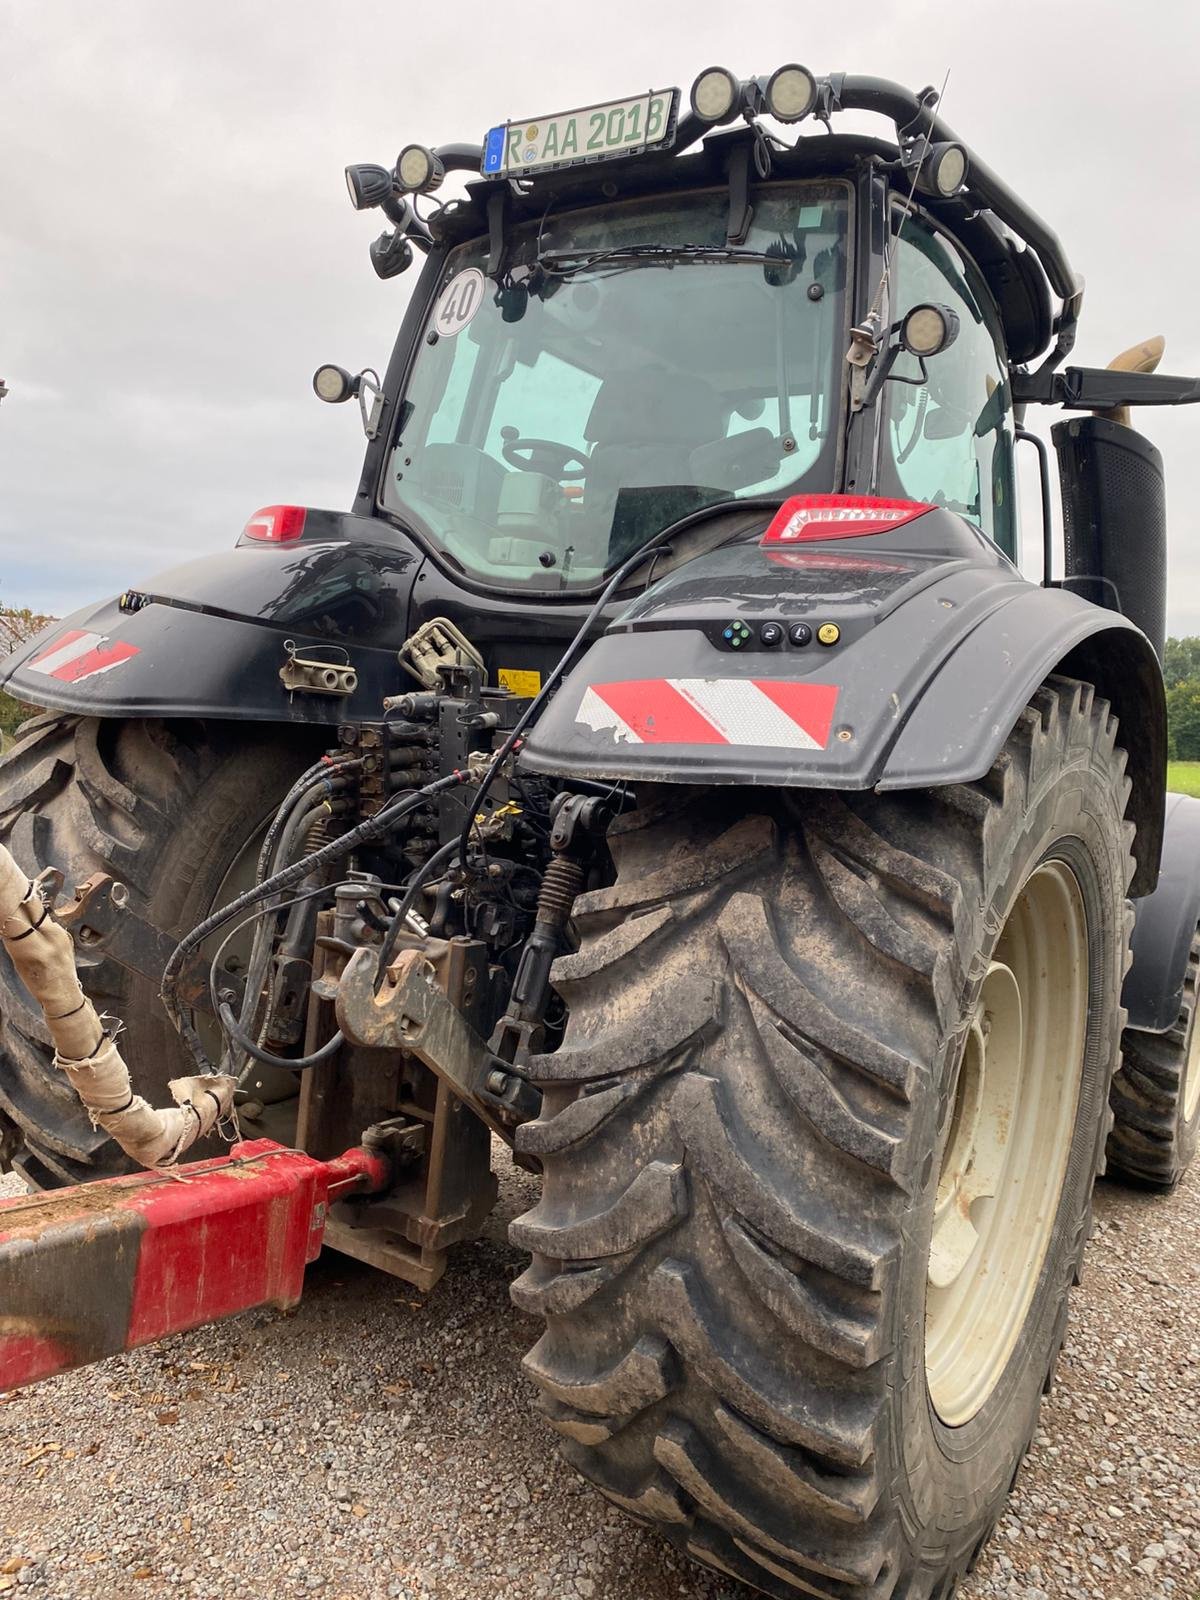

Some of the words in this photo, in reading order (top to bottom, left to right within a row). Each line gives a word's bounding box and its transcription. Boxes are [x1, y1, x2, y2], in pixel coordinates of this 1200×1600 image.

[504, 129, 522, 164] R
[541, 118, 577, 158] AA
[587, 98, 664, 150] 2018
[490, 154, 497, 165] D
[441, 279, 477, 324] 40
